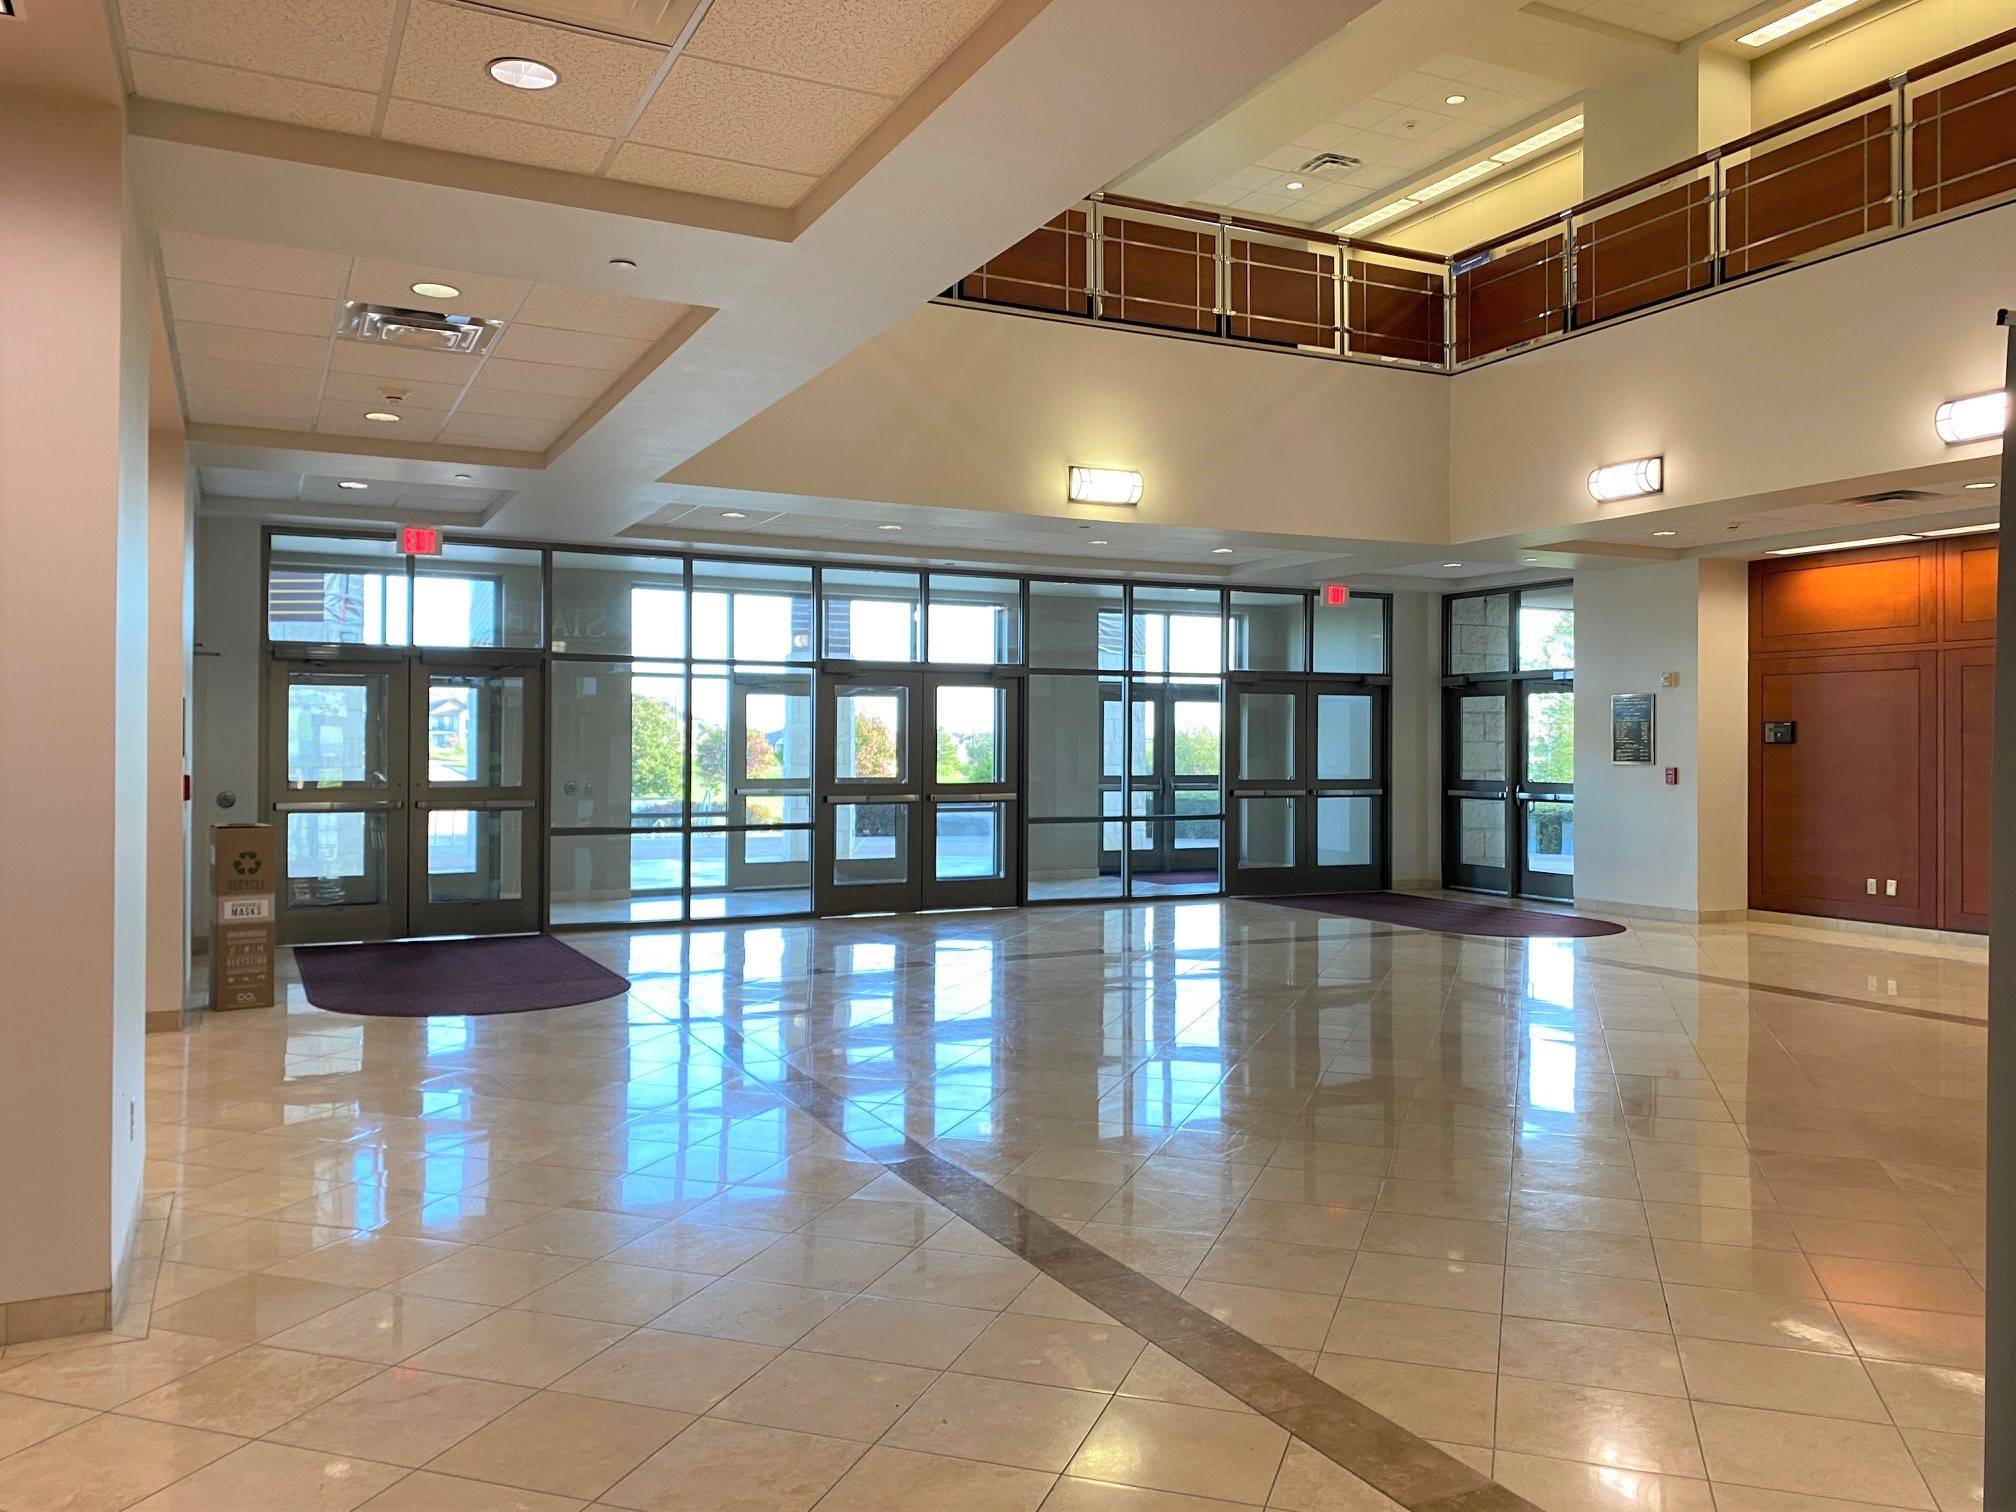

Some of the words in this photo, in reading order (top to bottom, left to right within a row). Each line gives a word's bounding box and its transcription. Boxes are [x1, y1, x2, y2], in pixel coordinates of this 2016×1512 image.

[404, 528, 436, 553] EXIT
[1328, 586, 1345, 604] EXIT
[231, 908, 262, 917] MASKS
